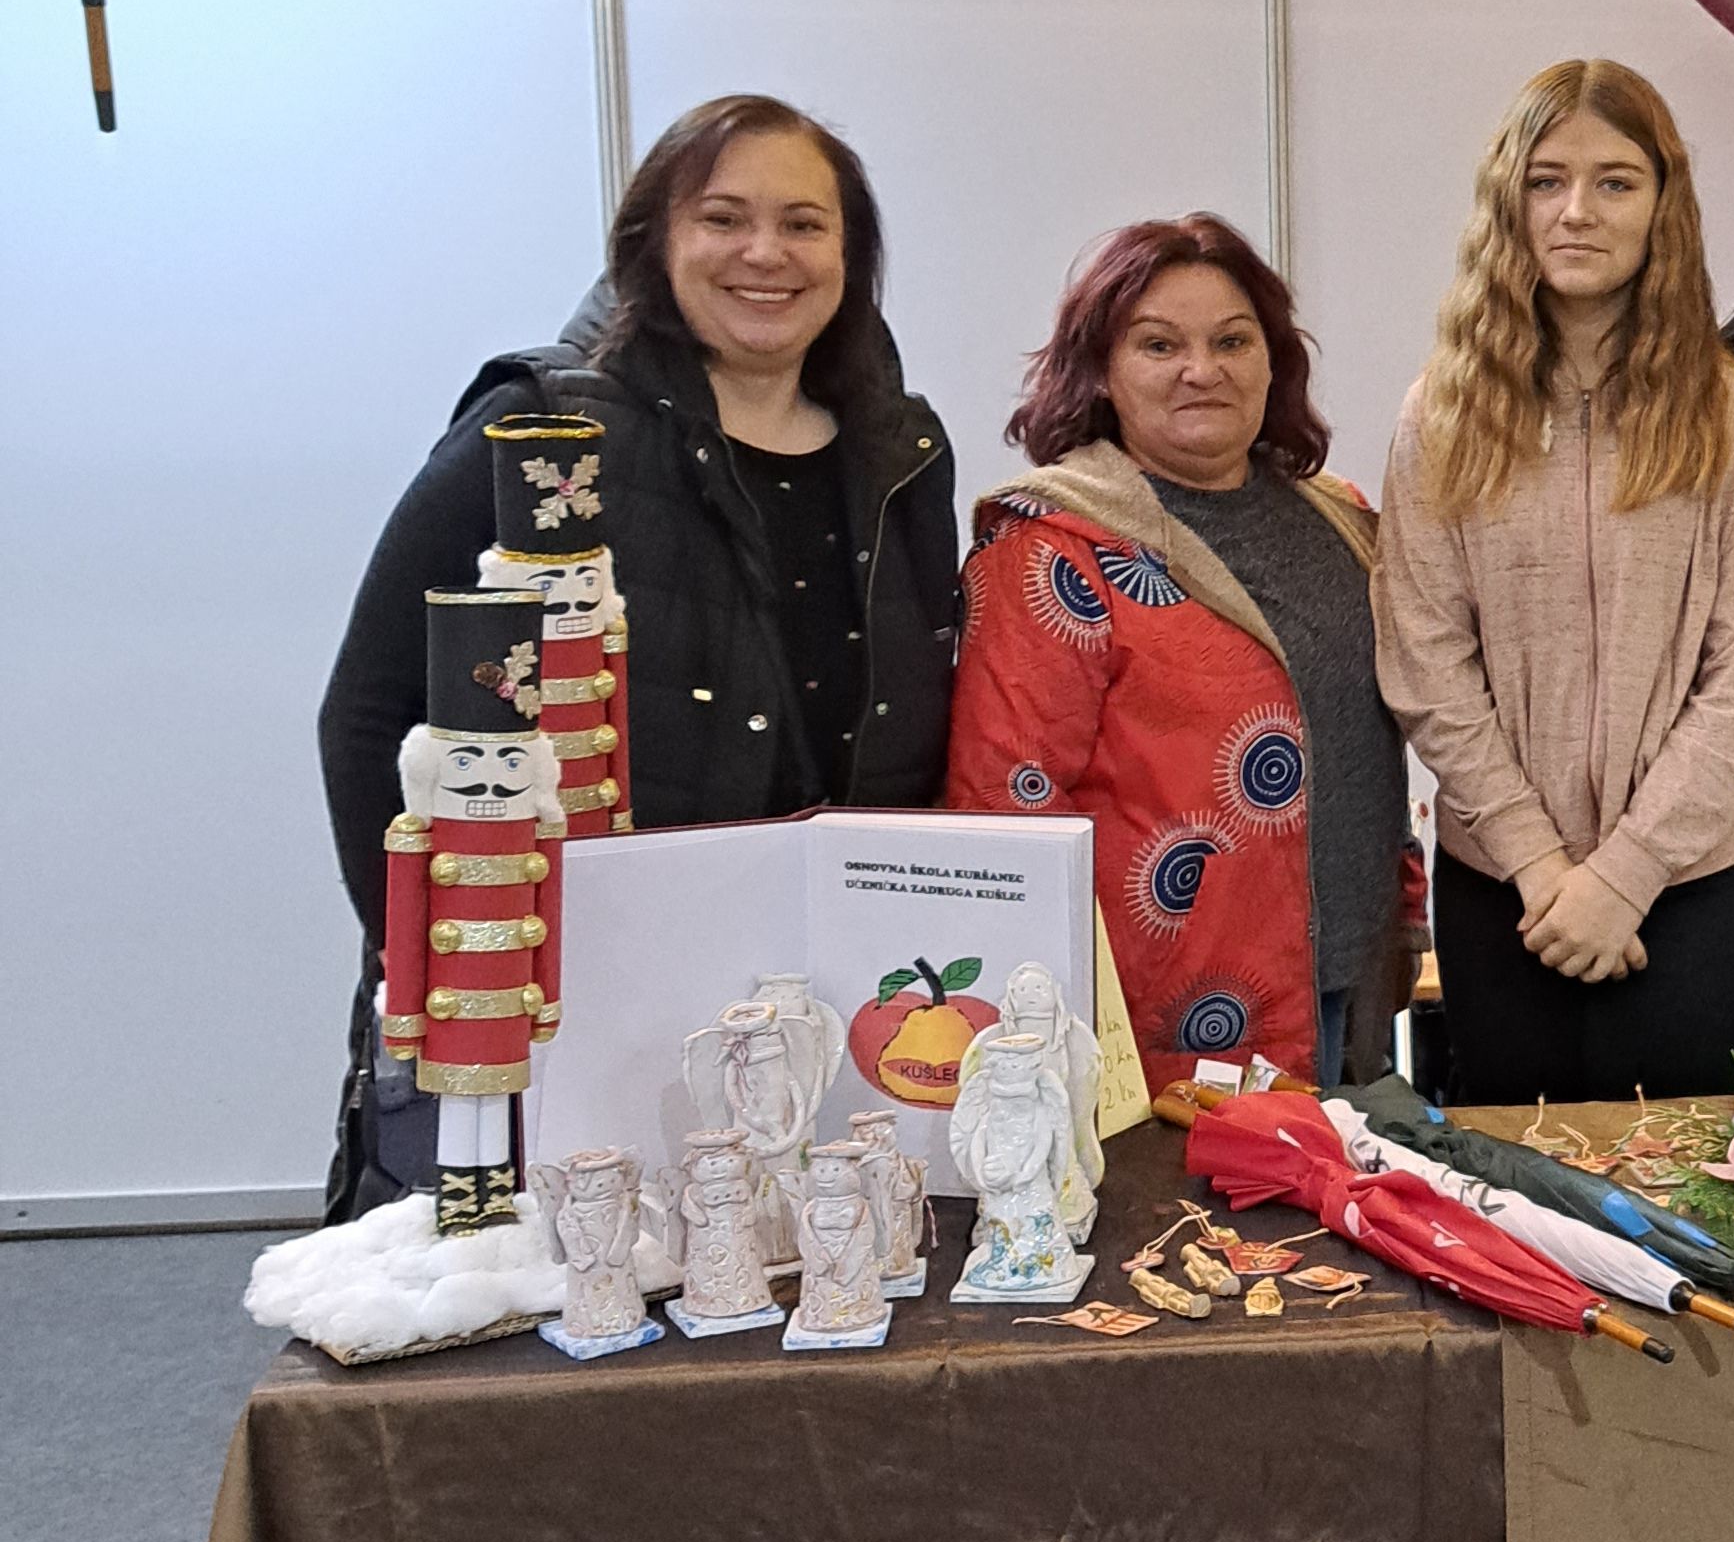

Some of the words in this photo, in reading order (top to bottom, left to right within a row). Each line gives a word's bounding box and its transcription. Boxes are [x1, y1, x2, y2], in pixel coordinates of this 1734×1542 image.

[845, 861, 906, 875] OSNOVNA
[910, 863, 951, 879] ŠKOLA
[955, 868, 1025, 884] KURŠANEC
[911, 884, 973, 899] ZADRUGA
[976, 889, 1026, 902] KUŠLEC
